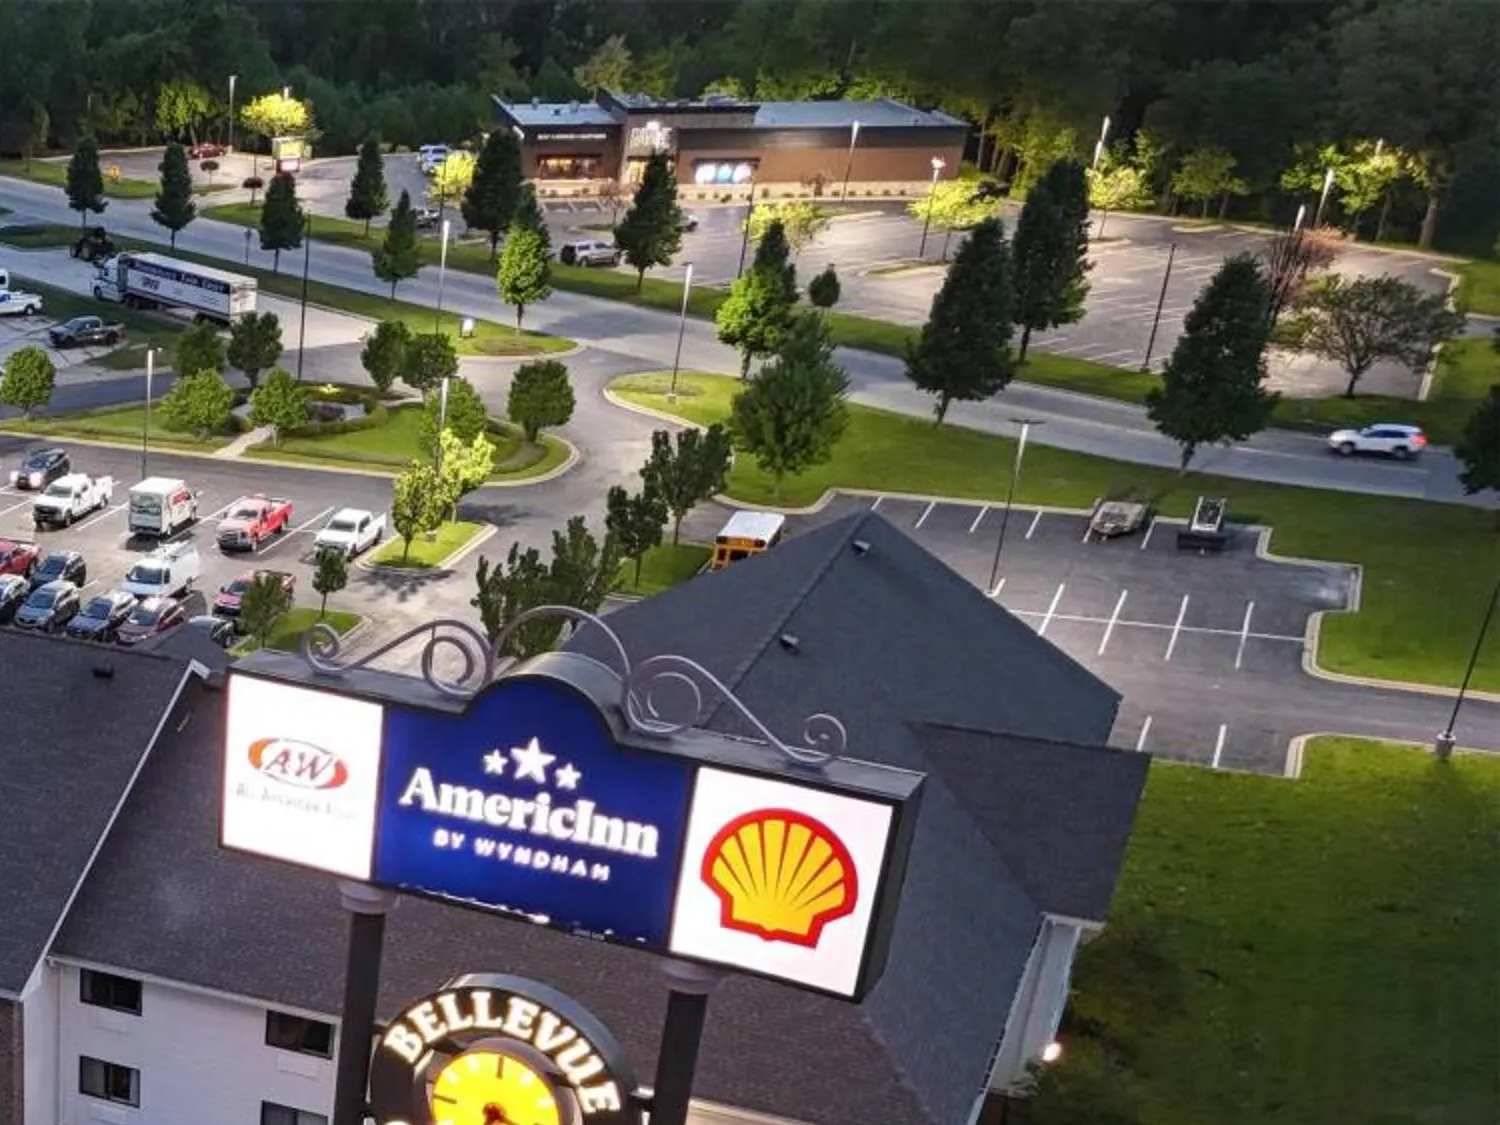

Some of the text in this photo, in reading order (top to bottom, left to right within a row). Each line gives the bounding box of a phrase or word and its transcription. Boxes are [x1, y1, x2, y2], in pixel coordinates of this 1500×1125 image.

[398, 767, 660, 858] AmericInn
[432, 828, 611, 882] BY WYNDHAM
[382, 990, 621, 1114] BELLEVUE
